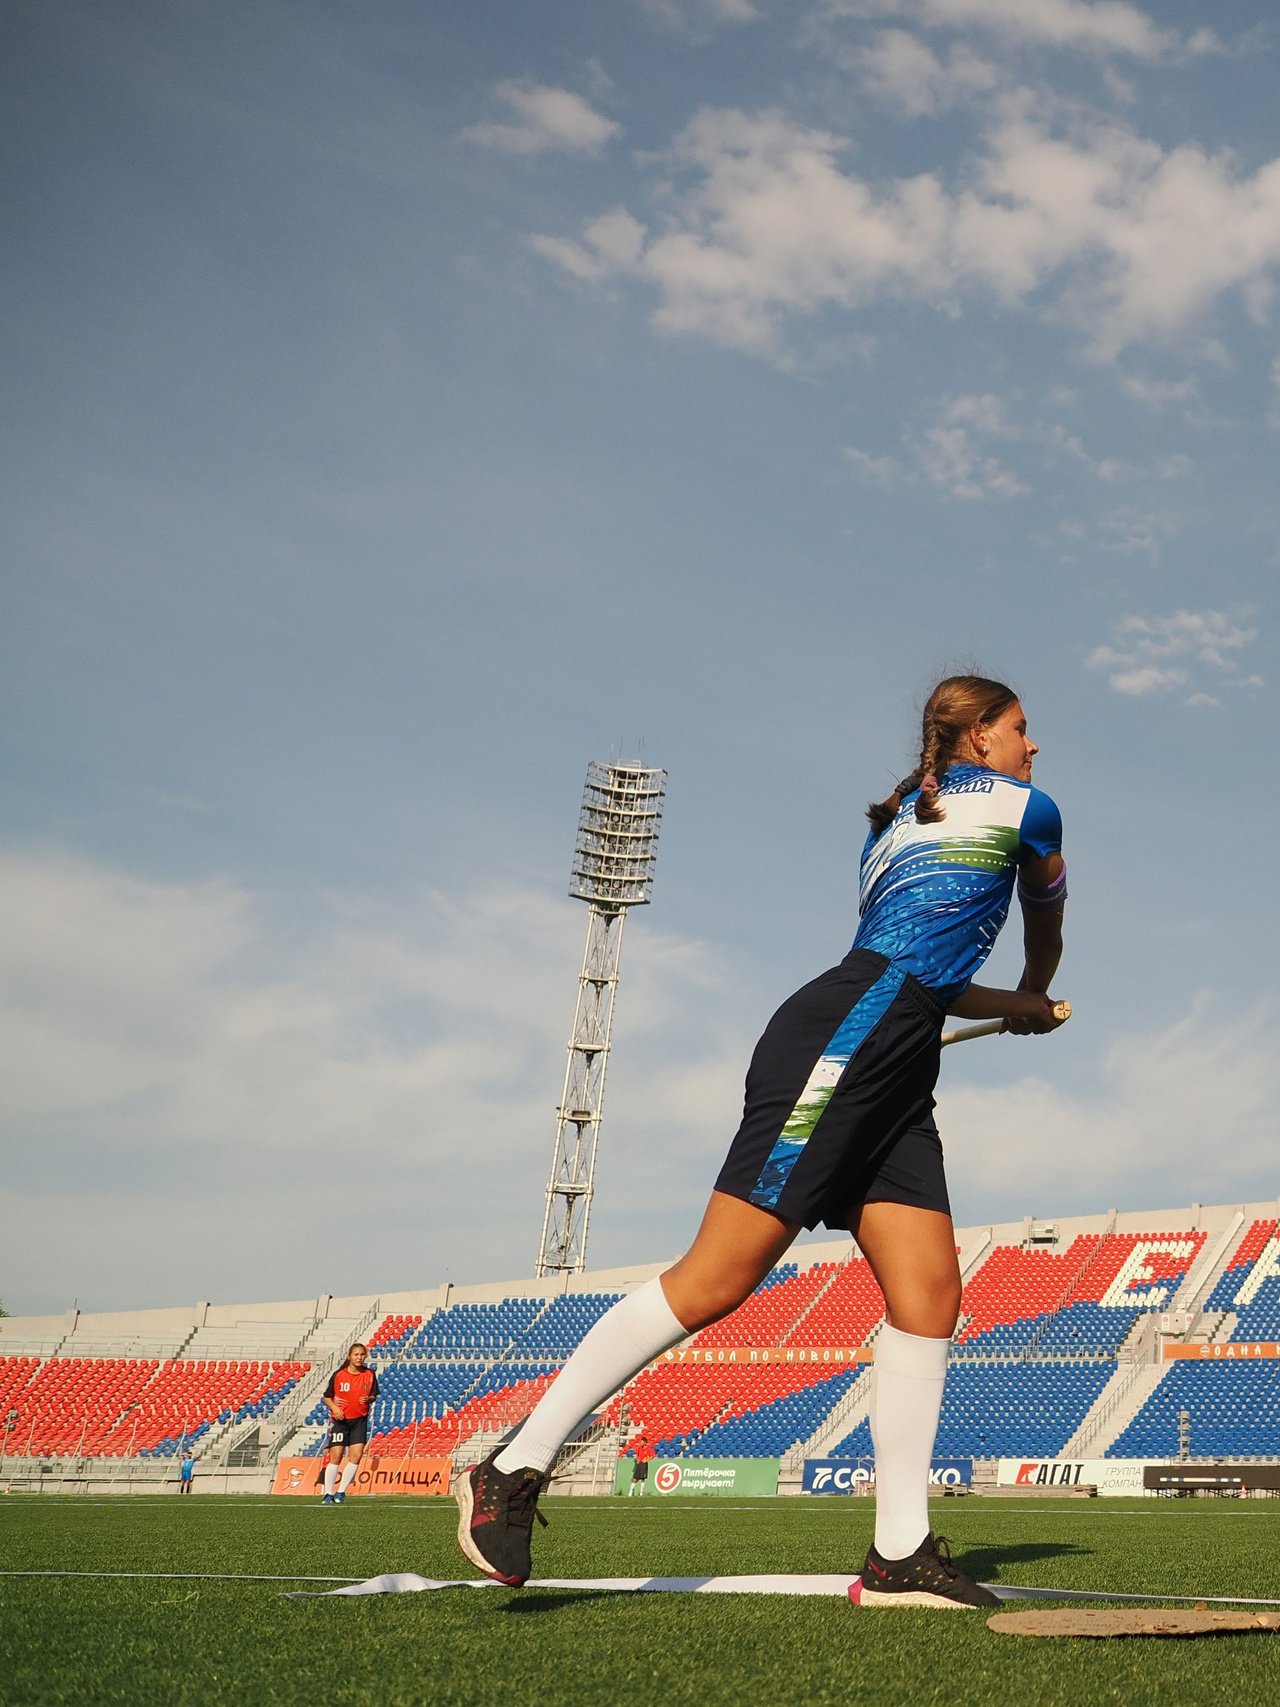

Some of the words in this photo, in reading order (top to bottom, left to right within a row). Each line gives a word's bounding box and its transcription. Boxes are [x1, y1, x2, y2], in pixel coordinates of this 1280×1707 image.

[937, 778, 991, 796] СКИЙ
[664, 1350, 737, 1362] ФУТБОЛ
[1214, 1345, 1262, 1357] ОДНА
[339, 1382, 350, 1392] 10
[331, 1432, 344, 1443] 10
[683, 1467, 736, 1478] Пятёрочка
[1035, 1464, 1084, 1485] АГАТ
[1105, 1467, 1141, 1476] ГРУППА
[681, 1479, 735, 1489] выручает!
[1102, 1479, 1143, 1489] КОМПАН
